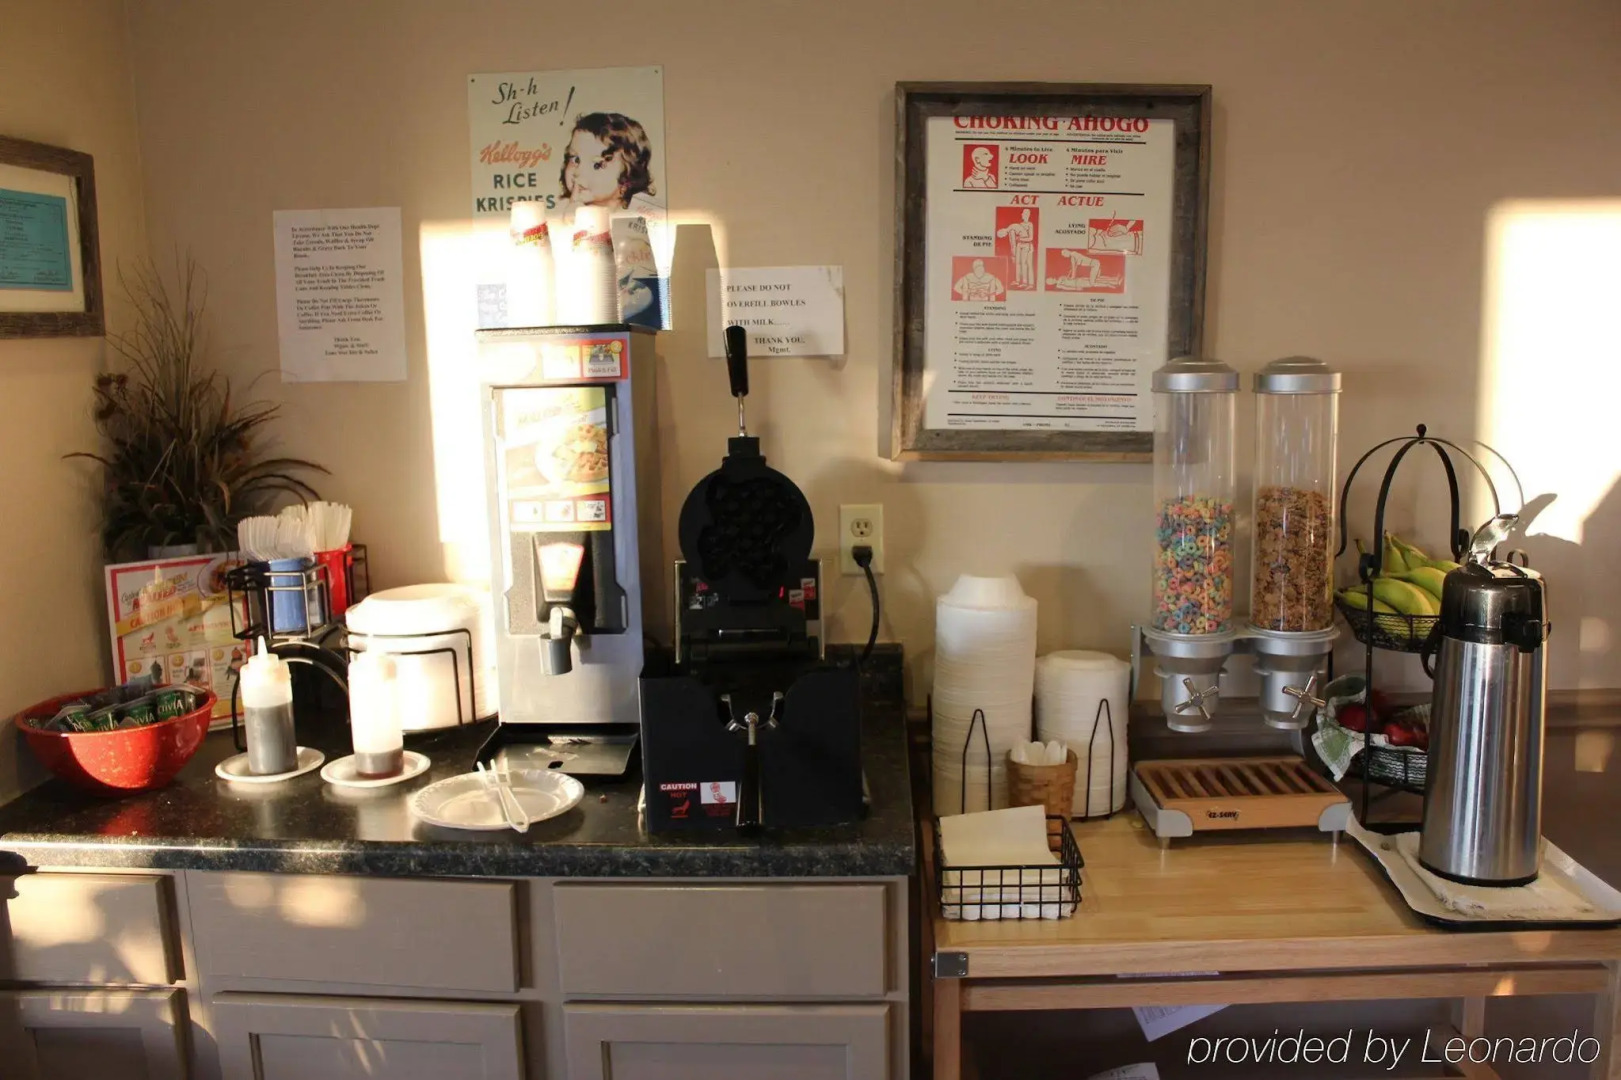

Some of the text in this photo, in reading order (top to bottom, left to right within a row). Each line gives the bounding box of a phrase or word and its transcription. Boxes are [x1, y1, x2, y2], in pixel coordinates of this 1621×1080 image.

[491, 77, 538, 105] Sh-h
[953, 114, 1149, 133] CHOKING AHOGO
[480, 140, 552, 168] Kellogg's
[1009, 153, 1048, 164] LOOK
[1070, 154, 1108, 166] MIRE
[493, 172, 537, 189] RICE
[1010, 194, 1039, 206] ACT
[1057, 196, 1105, 207] ACTUE
